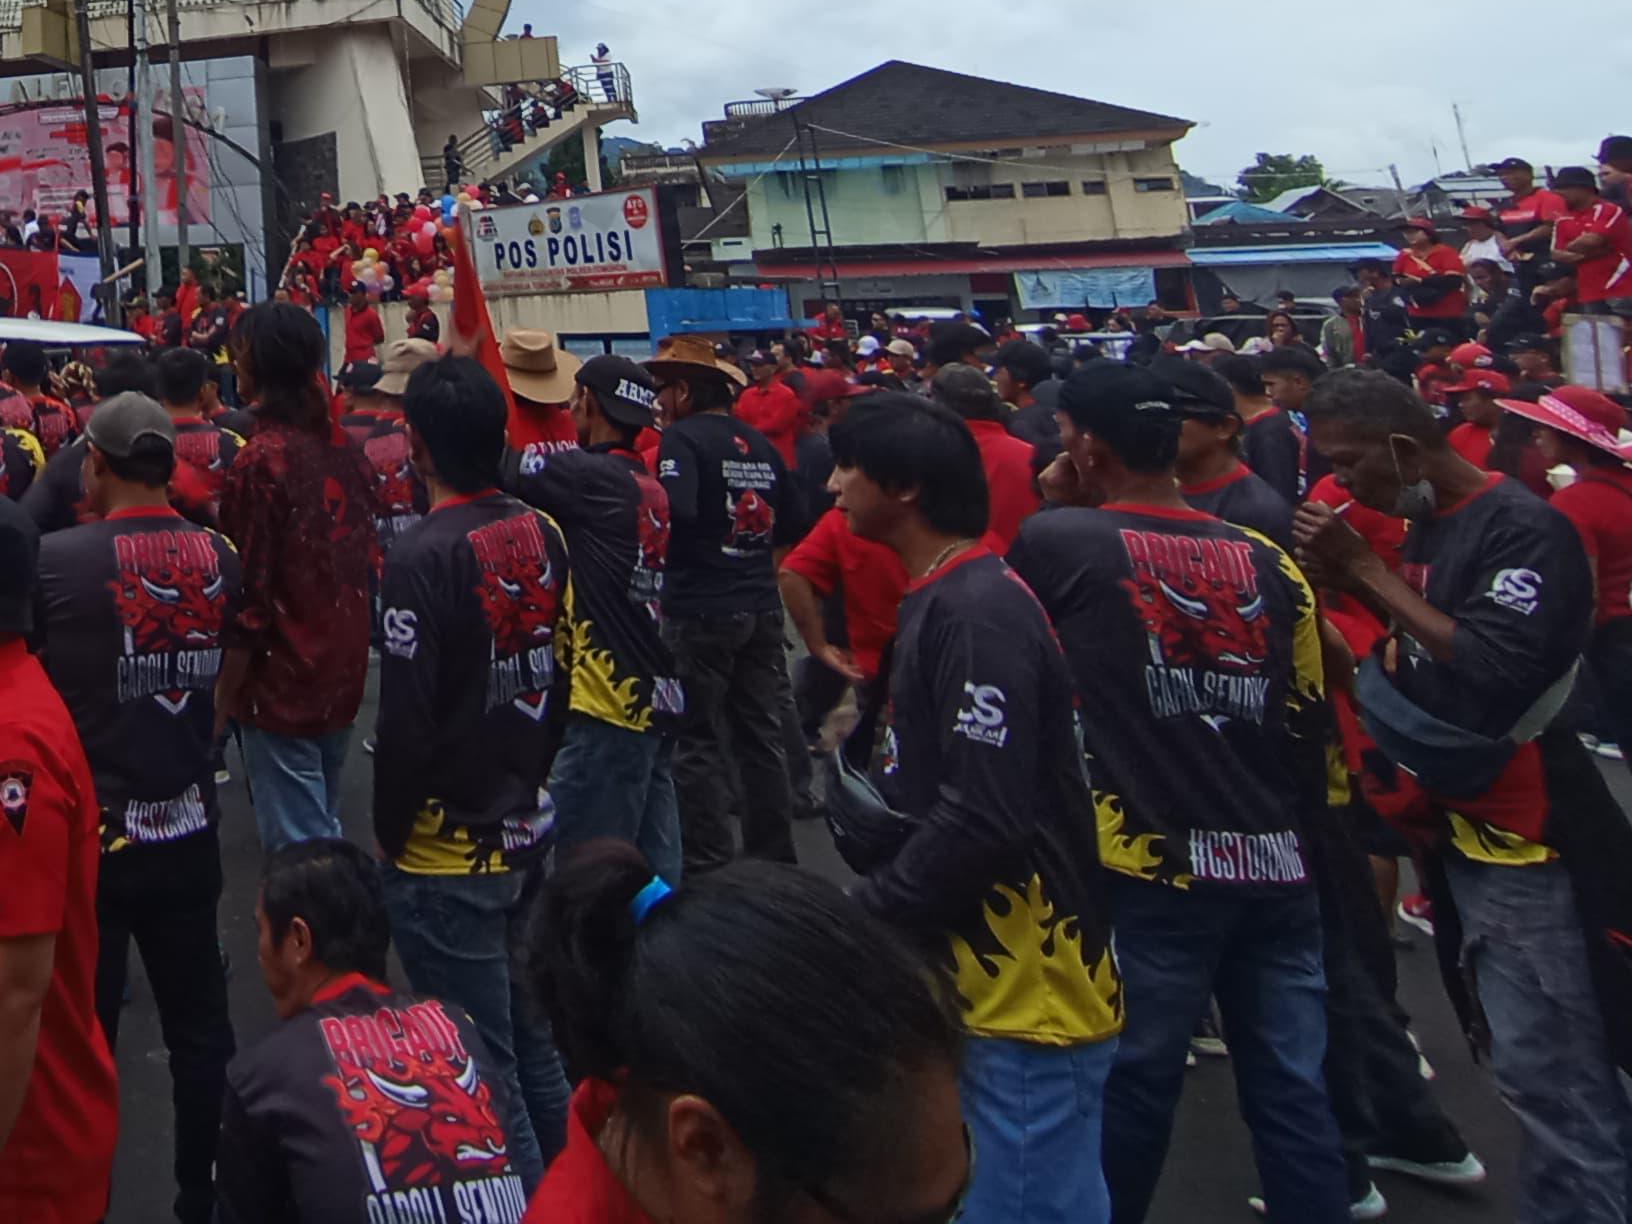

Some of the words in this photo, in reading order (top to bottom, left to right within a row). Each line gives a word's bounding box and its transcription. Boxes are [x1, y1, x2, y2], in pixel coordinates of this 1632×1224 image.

[494, 239, 537, 270] POS
[547, 229, 633, 266] POLISI
[114, 529, 219, 577] BRIGADE
[1119, 528, 1258, 594] BRIGADE
[1492, 567, 1544, 600] CS
[383, 607, 418, 643] CS
[118, 650, 170, 704] CAROLL
[1188, 827, 1306, 882] #CSTORANG
[319, 999, 469, 1070] BRIGADE
